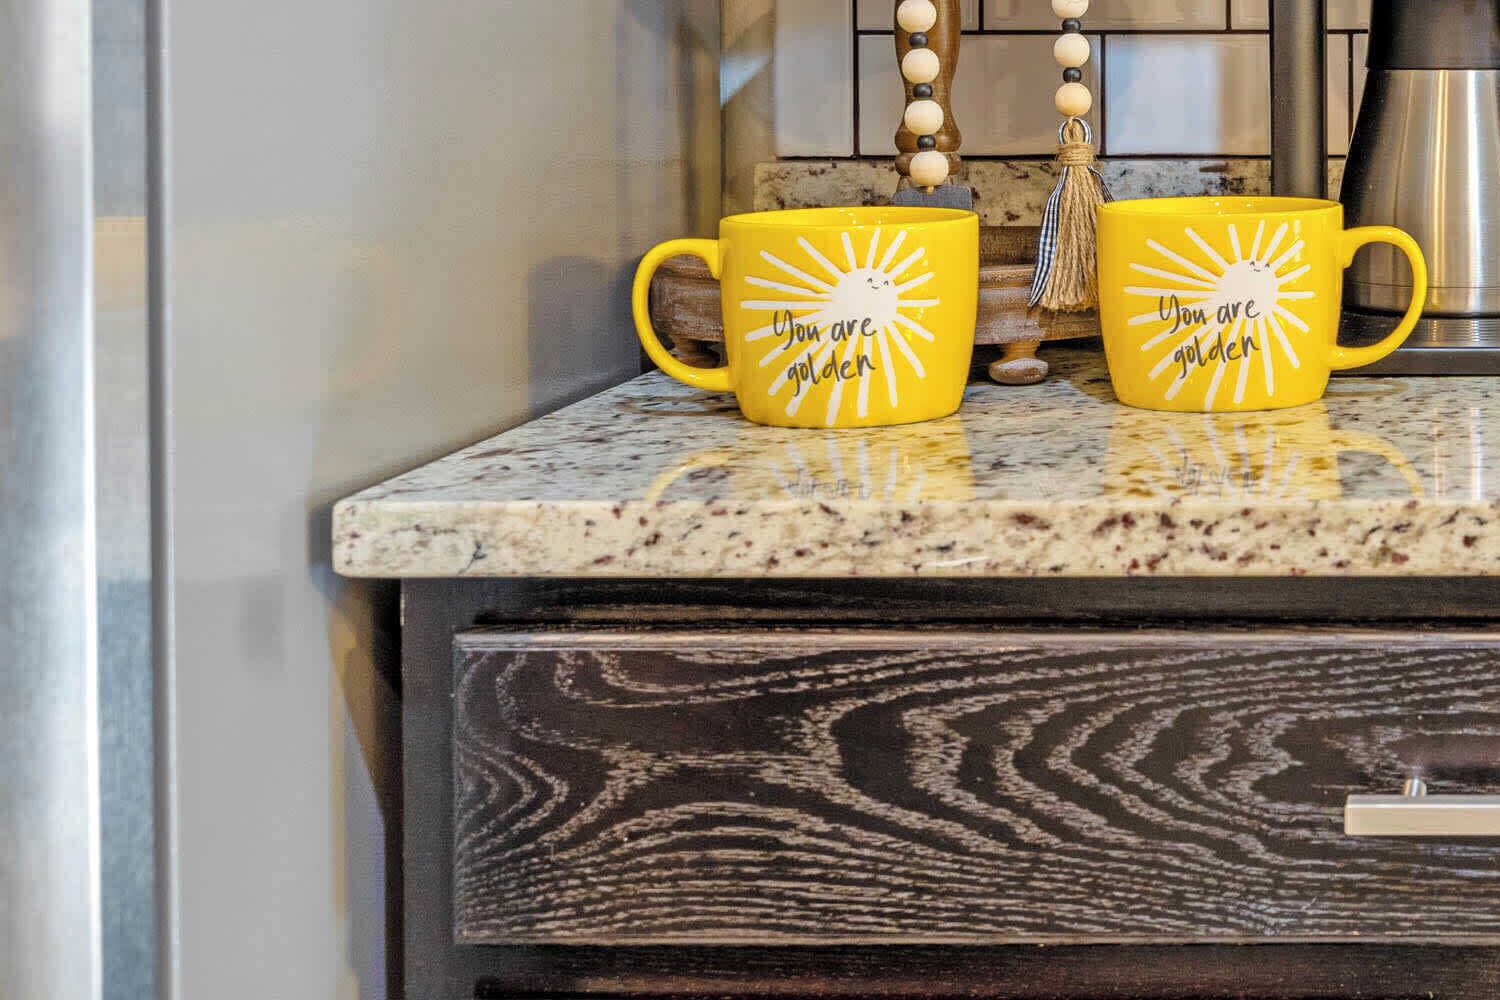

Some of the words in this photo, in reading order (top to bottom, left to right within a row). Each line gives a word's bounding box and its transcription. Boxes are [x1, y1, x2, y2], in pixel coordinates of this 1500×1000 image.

[773, 309, 820, 350] You
[831, 317, 877, 342] are
[1160, 294, 1207, 334] You
[1217, 300, 1261, 324] are
[787, 350, 876, 397] golden
[1174, 332, 1260, 379] golden
